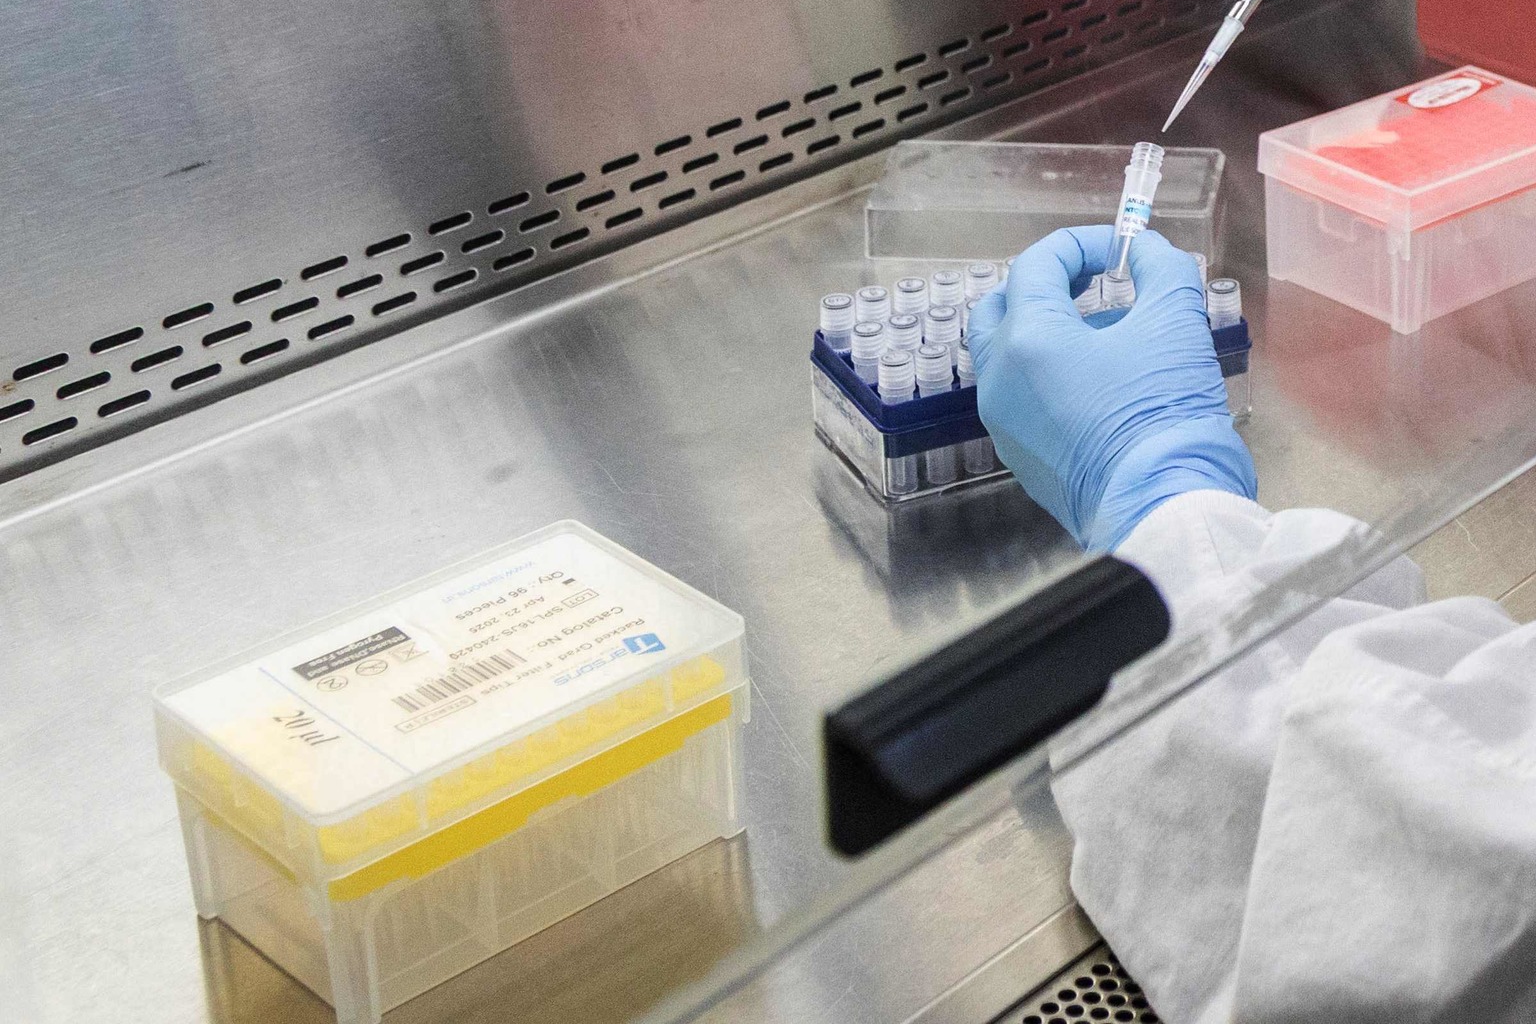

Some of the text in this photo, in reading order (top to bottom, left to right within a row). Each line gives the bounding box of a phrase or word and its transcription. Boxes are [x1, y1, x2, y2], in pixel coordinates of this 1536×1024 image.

[507, 587, 527, 598] 96
[523, 595, 545, 608] Apr
[568, 591, 593, 605] LOT
[455, 596, 506, 620] Pieces
[560, 606, 623, 635] Catalog
[594, 617, 645, 643] Racked
[308, 634, 383, 666] Pyrogen Free
[553, 633, 663, 686] Tarsons
[516, 661, 553, 680] Filter
[480, 680, 513, 695] Tips
[273, 710, 315, 729] 20
